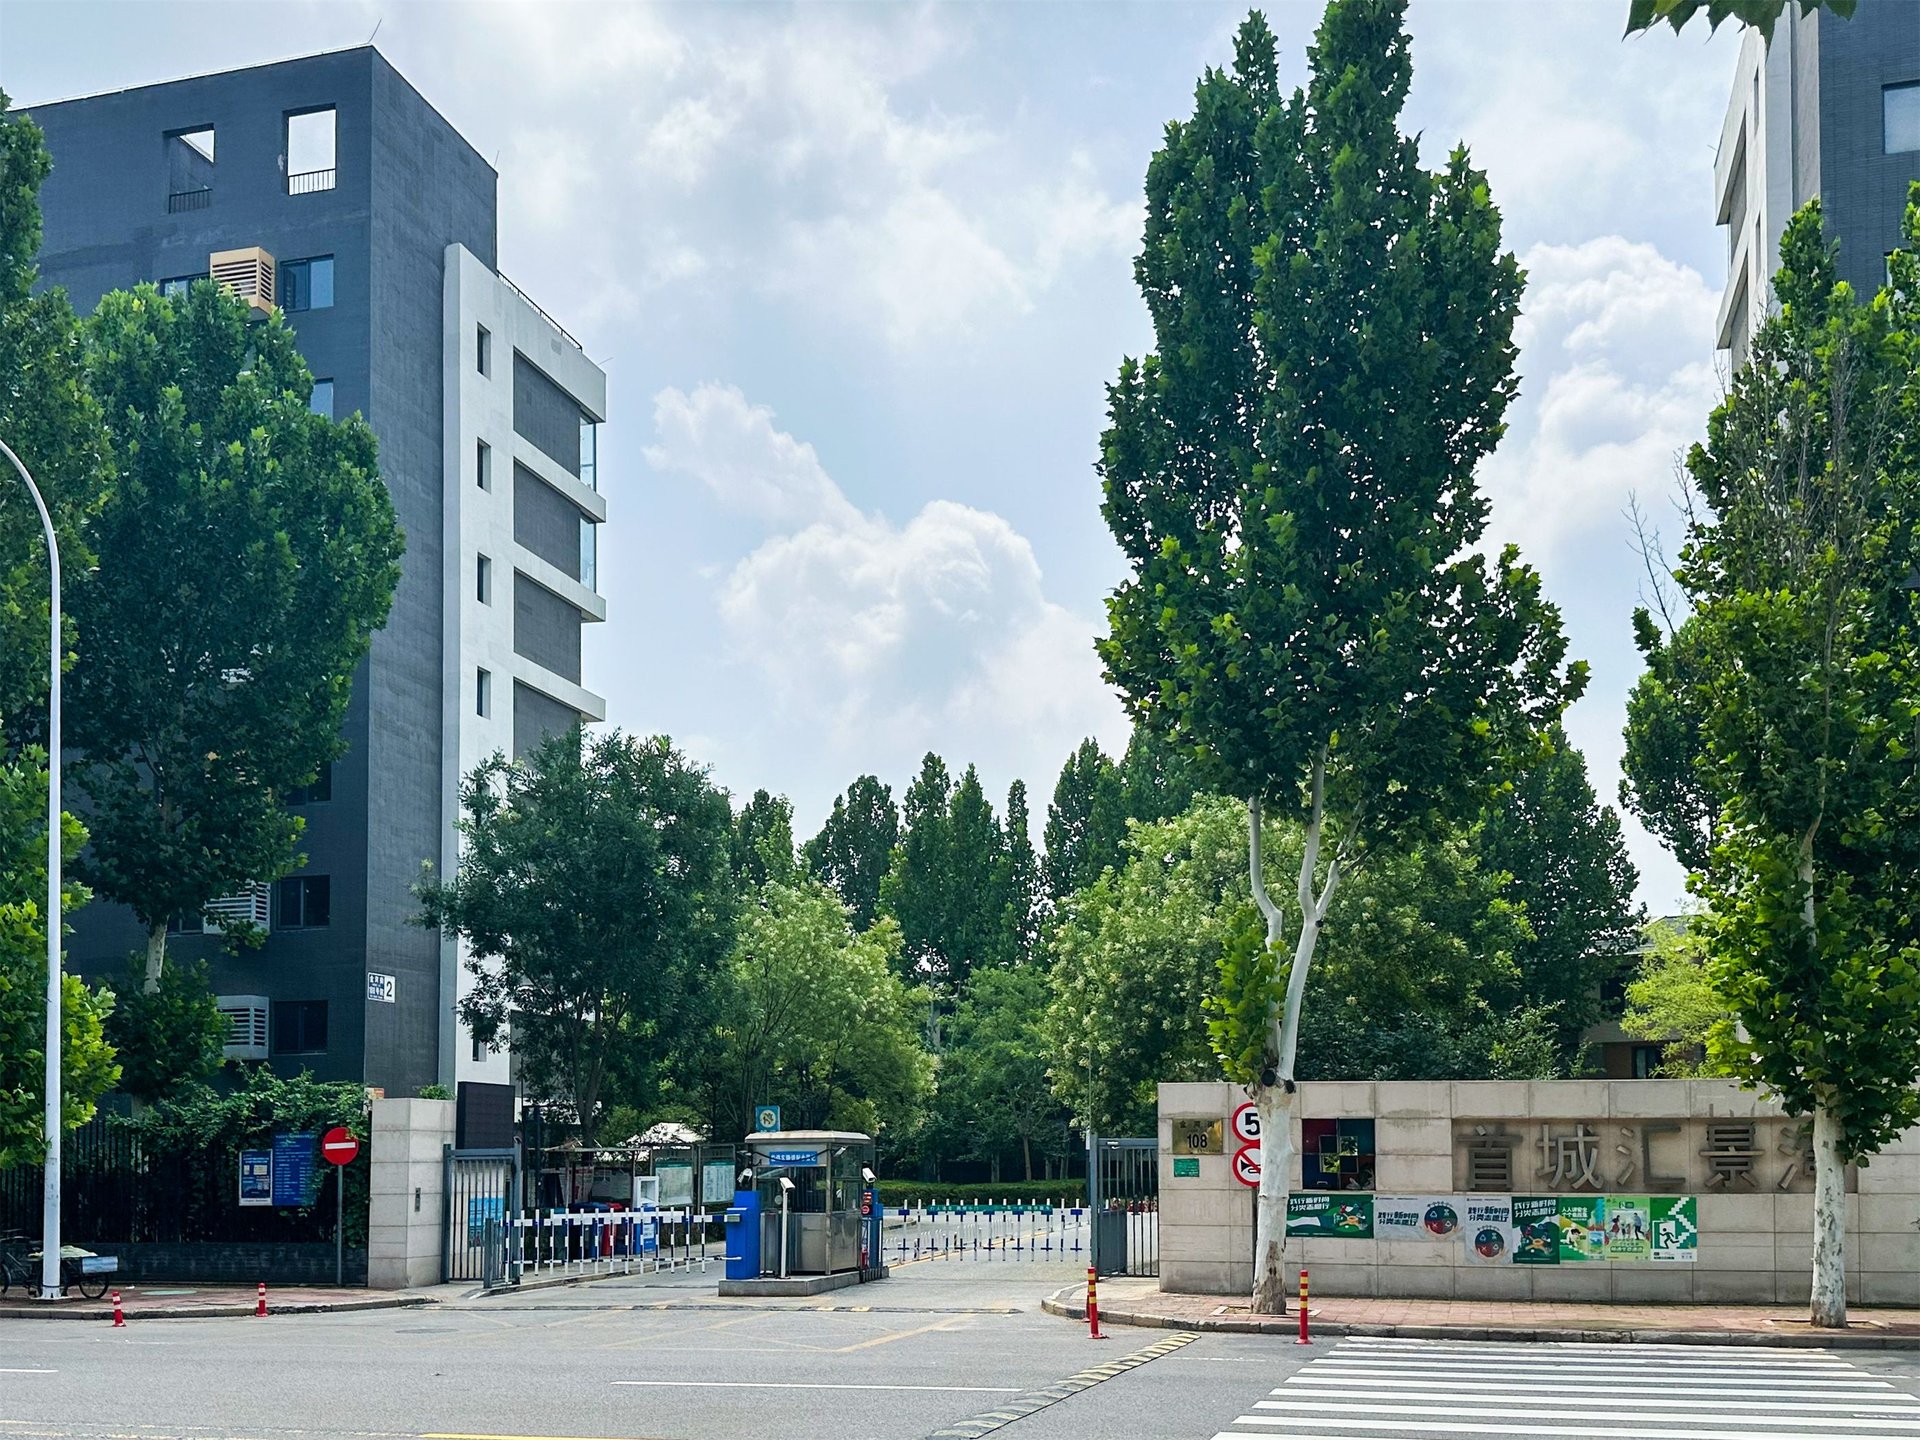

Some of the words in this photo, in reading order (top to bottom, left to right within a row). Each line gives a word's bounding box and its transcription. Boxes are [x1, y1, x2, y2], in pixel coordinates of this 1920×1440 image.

[386, 981, 393, 997] 2
[1245, 1112, 1260, 1136] 5
[1186, 1133, 1208, 1149] 108
